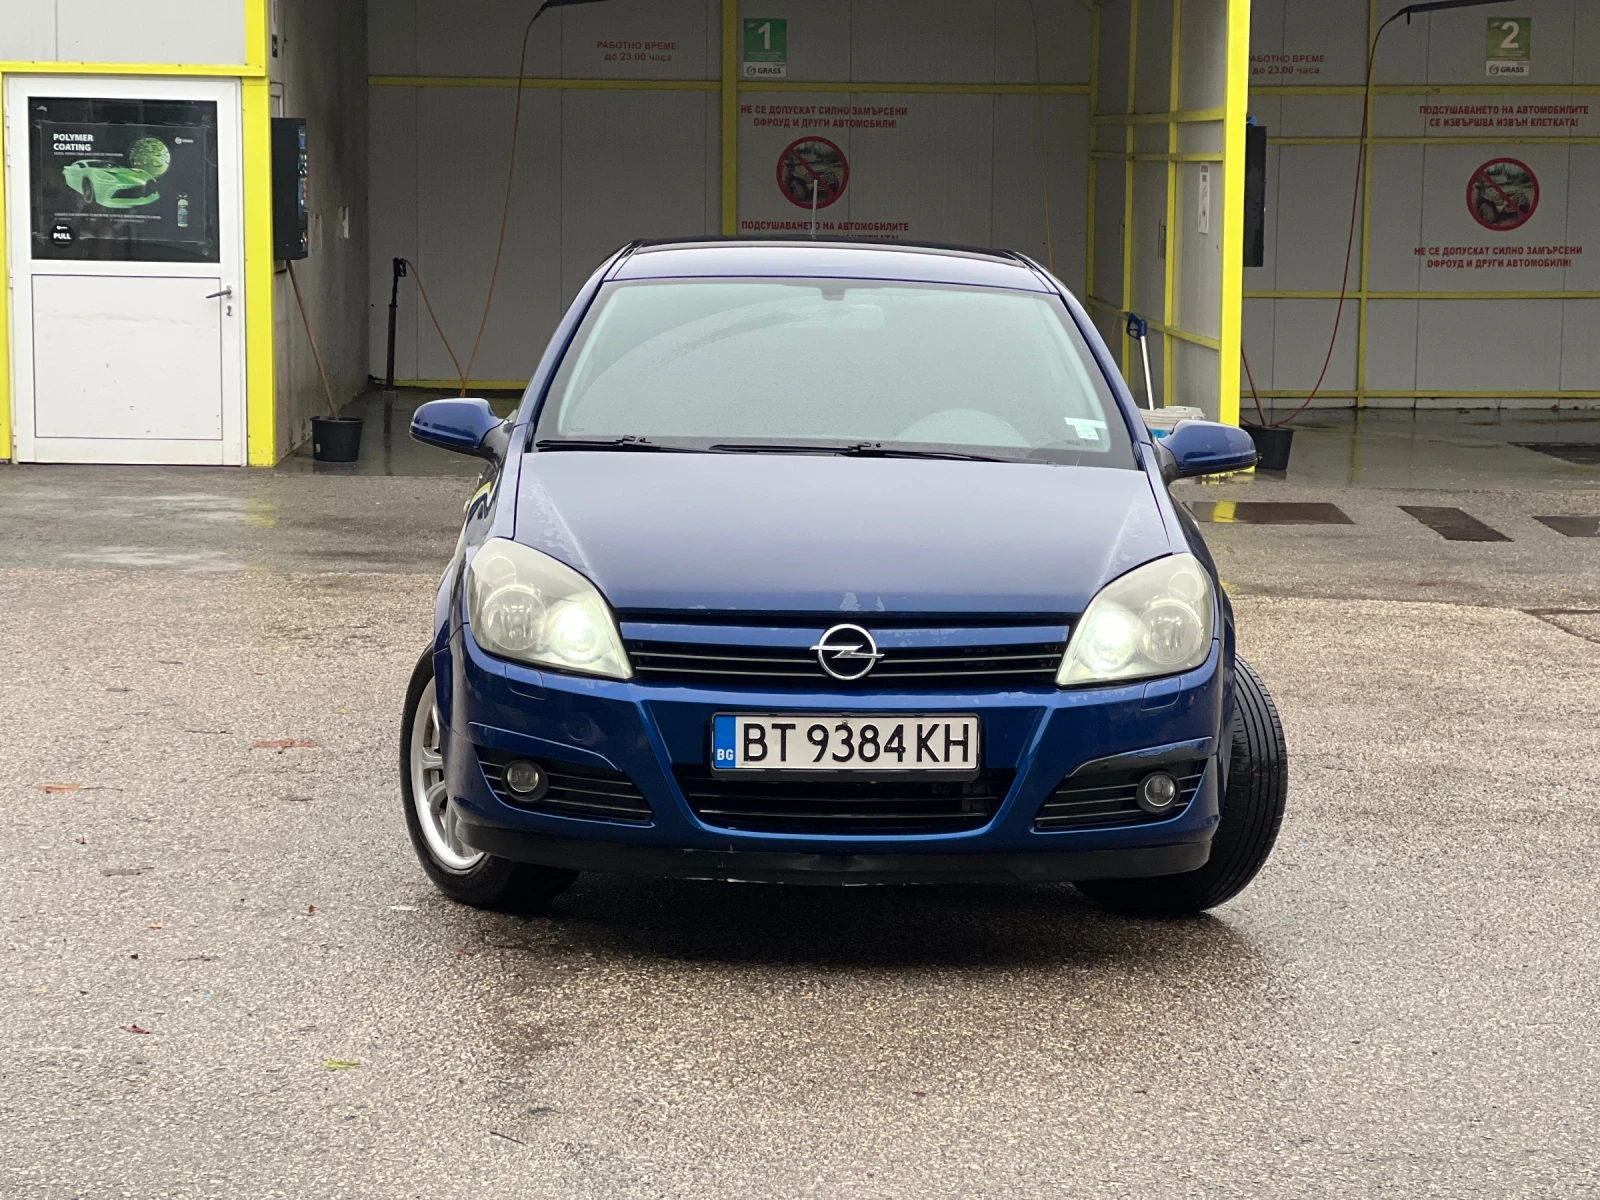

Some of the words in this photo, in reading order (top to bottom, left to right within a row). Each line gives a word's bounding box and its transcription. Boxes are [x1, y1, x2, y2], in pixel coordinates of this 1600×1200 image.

[757, 21, 771, 50] 1
[1500, 21, 1520, 49] 2
[596, 41, 642, 49] РАБОТНО
[604, 53, 618, 62] до
[620, 52, 646, 61] 23.00
[1250, 55, 1290, 63] АБОТНО
[1292, 55, 1328, 63] ВРЕМЕ:
[1252, 67, 1265, 75] до
[1268, 66, 1294, 74] 23.00
[741, 105, 753, 114] НЕ
[755, 105, 766, 114] СЕ
[769, 105, 816, 116] ДОПУСКАТ
[818, 106, 850, 115] СИЛНО
[852, 106, 908, 116] ЗАМЪРСЕНИ
[1419, 105, 1499, 115] ПОДСУШАВАНЕТО
[1502, 106, 1514, 115] НА
[1516, 105, 1589, 115] АВТОМОБИЛИТЕ
[753, 119, 791, 128] ОФРОУД
[793, 119, 800, 127] И
[802, 119, 830, 129] ДРУГИ
[832, 119, 897, 129] АВТОМОБИЛИ!
[1429, 118, 1441, 127] СЕ
[1443, 118, 1494, 127] ИЗВЪРШВА
[1496, 118, 1528, 127] ИЗВЪН
[1530, 118, 1579, 127] КЛЕТКАТА!
[53, 133, 94, 142] POLYMER
[53, 143, 92, 152] COATING
[823, 222, 835, 230] НА
[837, 222, 909, 231] АВТОМОБИЛИТЕ
[53, 232, 72, 240] PULL
[1414, 247, 1426, 256] НЕ
[1429, 247, 1440, 256] СЕ
[1442, 247, 1490, 257] ДОПУСКАТ
[1493, 246, 1524, 255] СИЛНО
[1526, 246, 1583, 255] ЗАМЪРСЕНИ
[1427, 259, 1464, 269] ОФРОУД
[1466, 259, 1473, 267] И
[1475, 259, 1504, 269] ДРУГИ
[1506, 258, 1572, 268] АВТОМОБИЛИ!
[743, 723, 797, 762] BT
[806, 723, 906, 763] 9384
[916, 723, 969, 763] KH
[716, 748, 734, 761] BG
